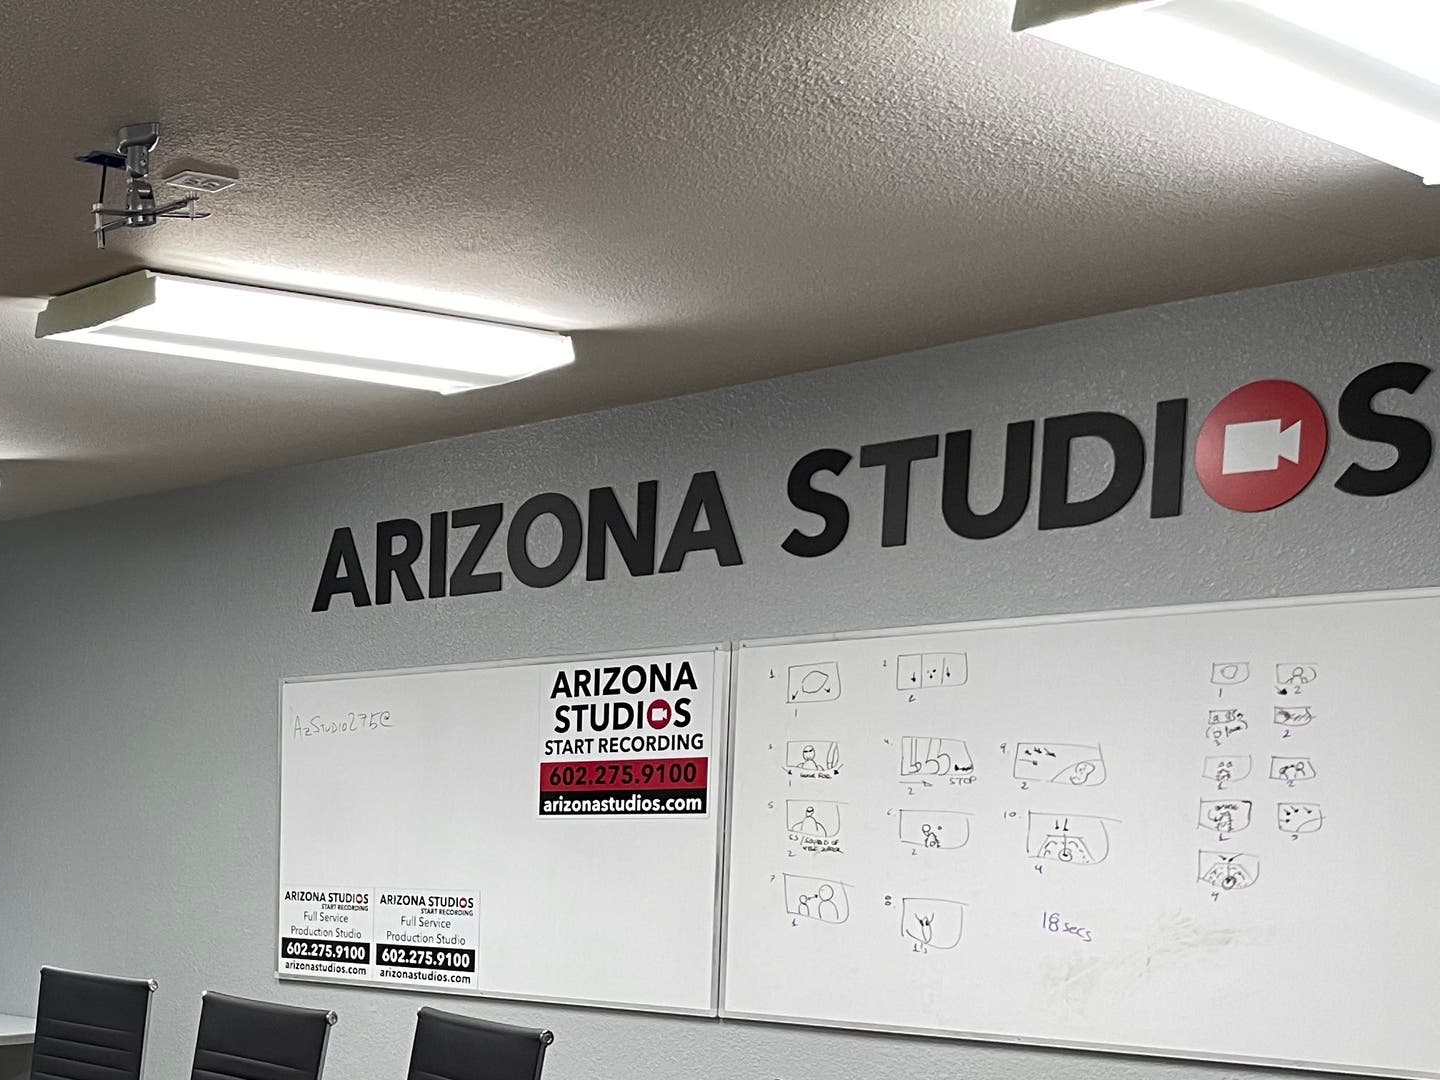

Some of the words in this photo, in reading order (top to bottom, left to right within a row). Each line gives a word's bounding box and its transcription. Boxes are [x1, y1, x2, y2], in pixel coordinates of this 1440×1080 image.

[311, 469, 745, 613] ARIZONA
[780, 360, 1434, 559] STUDIOS
[550, 661, 698, 699] ARIZONA
[554, 697, 692, 734] STUDIOS
[545, 738, 594, 755] START
[598, 733, 704, 753] RECORDING
[549, 762, 697, 786] 602.275.9100
[949, 776, 977, 786] STOP
[543, 794, 702, 812] arizonastudios.com
[284, 891, 326, 902] ARIZONA
[328, 892, 369, 904] STUDIOS
[380, 894, 426, 906] ARIZONA
[428, 897, 474, 909] STUDIOS
[303, 911, 318, 921] Full
[319, 912, 349, 923] Service
[438, 909, 474, 917] RECORDING
[401, 915, 417, 927] Full
[419, 917, 451, 928] Service
[290, 926, 334, 937] Production
[335, 928, 362, 939] Studio
[386, 931, 435, 944] Production
[437, 933, 466, 945] Studio
[286, 941, 366, 960] 602.275.9100
[381, 948, 470, 968] 602.275.9100
[285, 960, 367, 976] arizonastudios.com
[379, 967, 471, 984] arizonastudios.com
